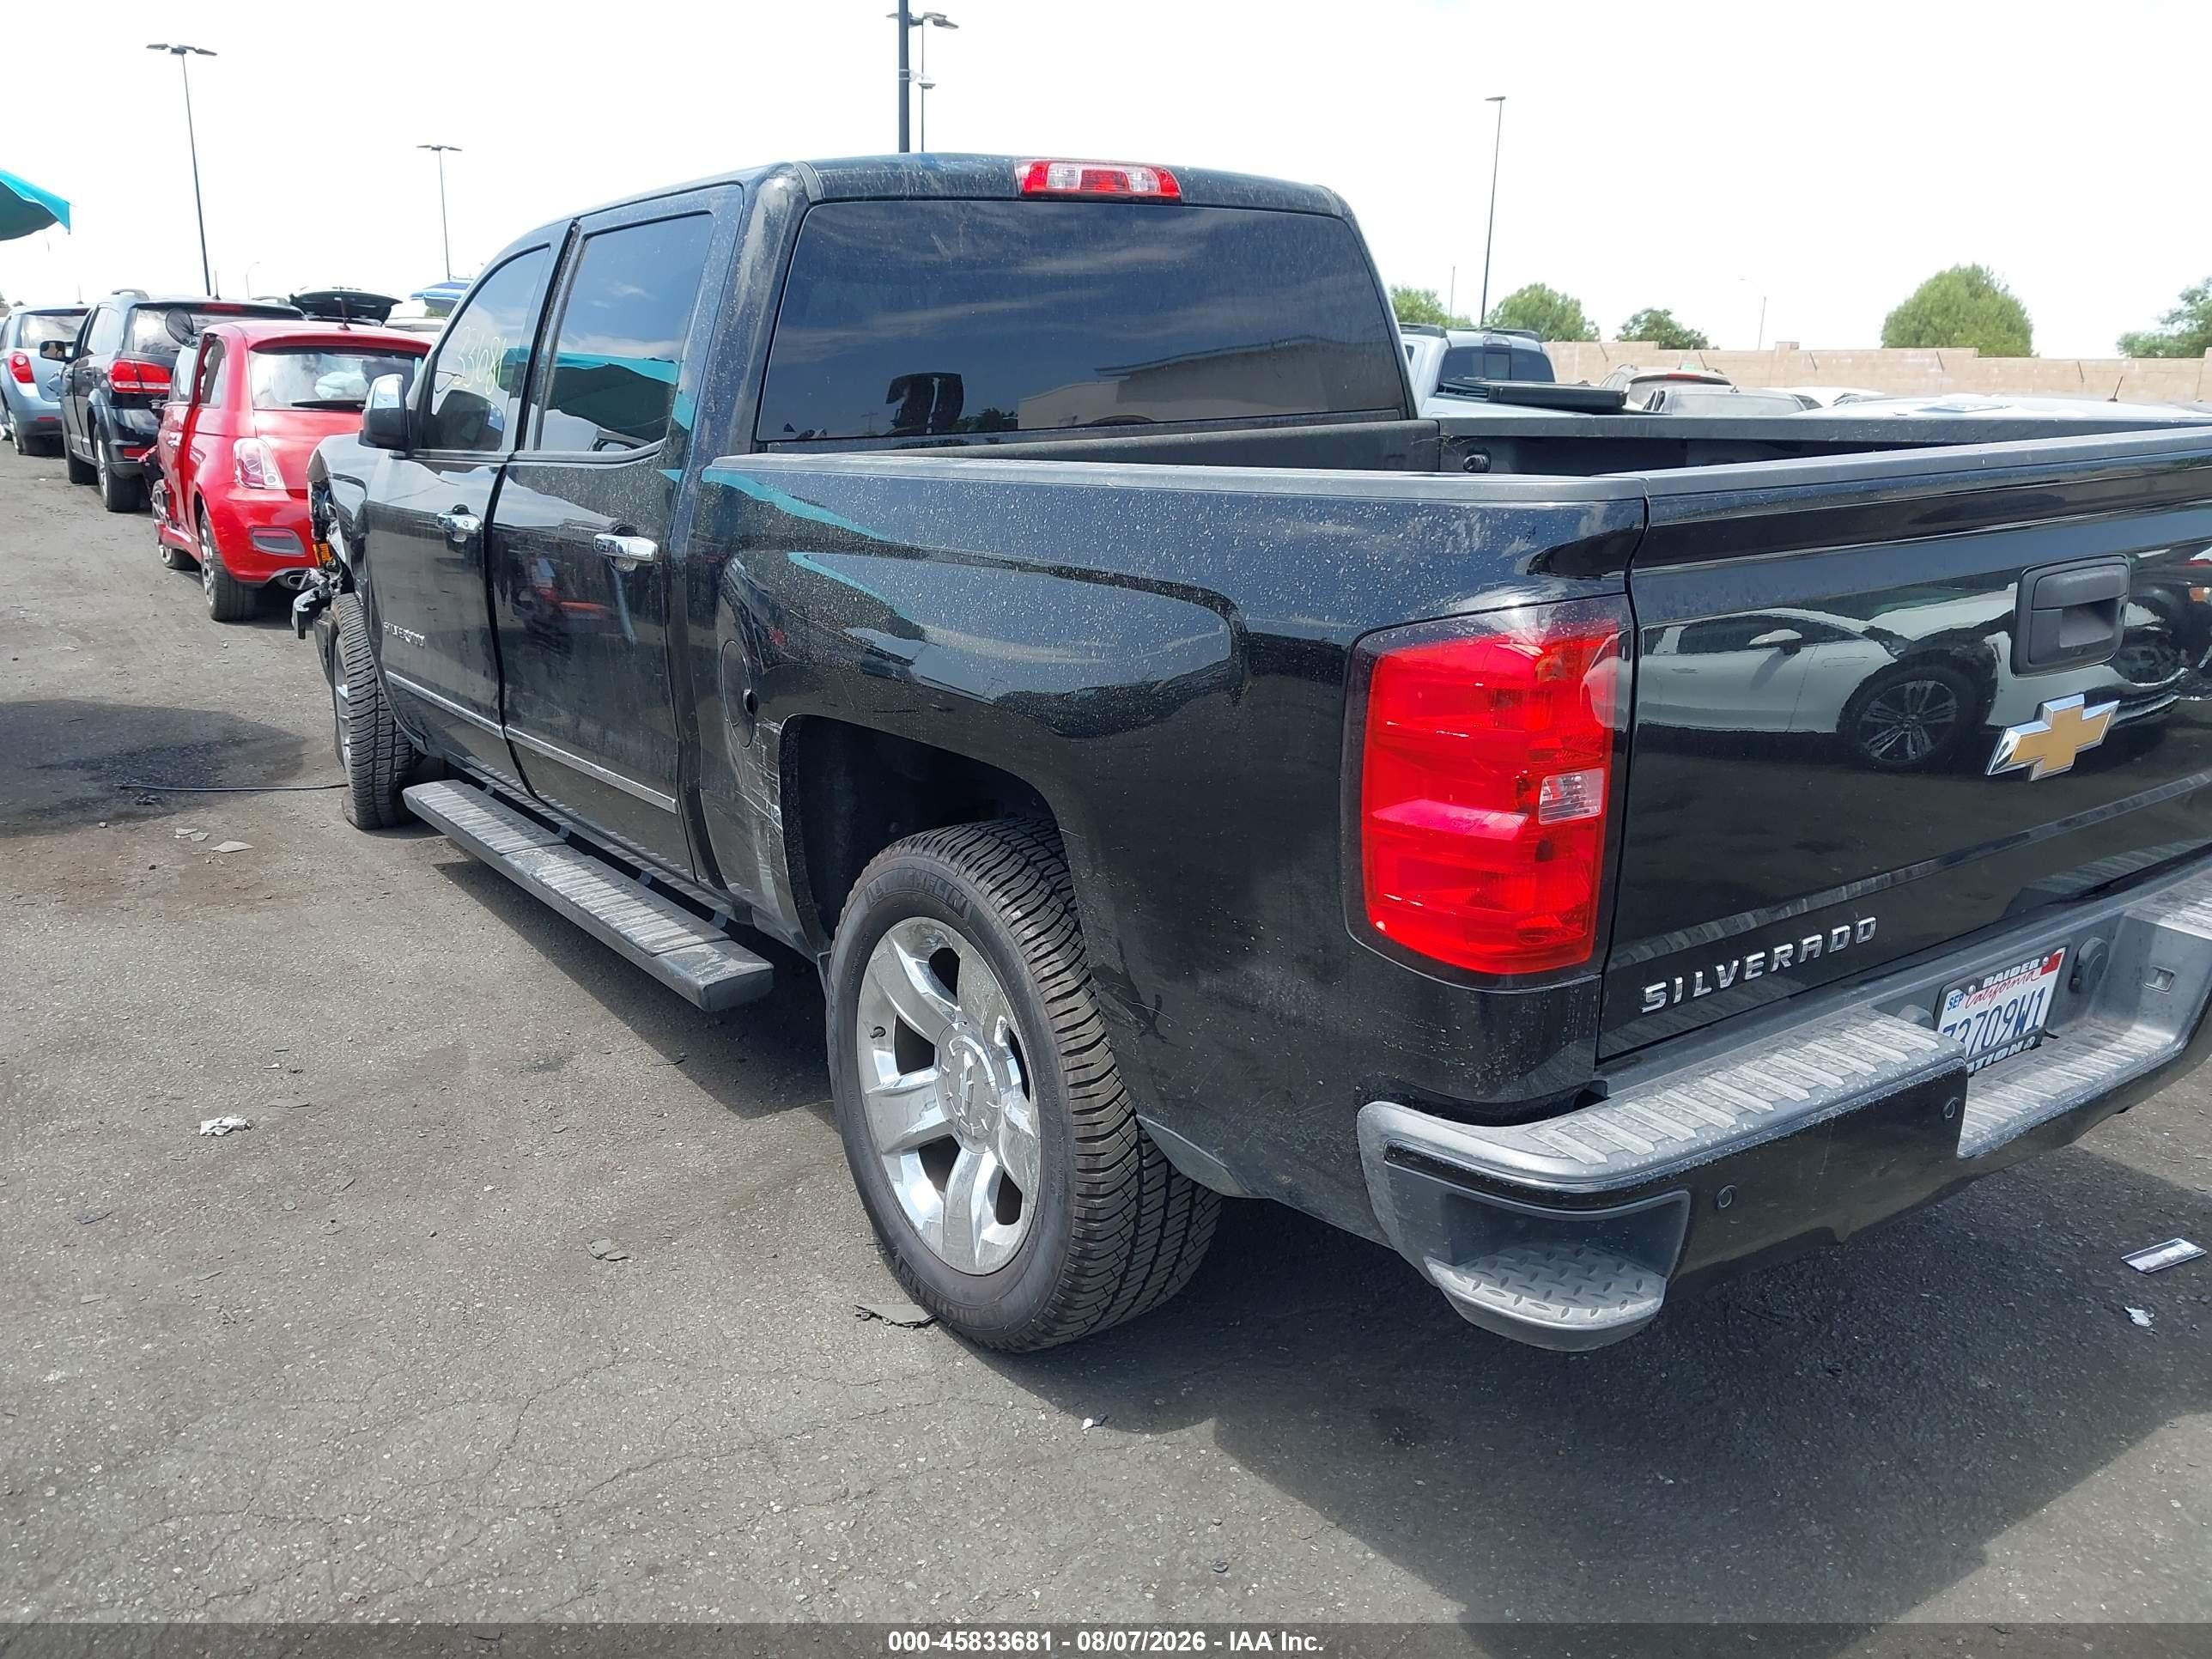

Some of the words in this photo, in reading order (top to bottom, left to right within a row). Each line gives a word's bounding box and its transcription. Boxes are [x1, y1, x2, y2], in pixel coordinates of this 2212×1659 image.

[1641, 916, 1877, 1013] SILVERADO
[1982, 958, 2040, 989] RAIDER
[1947, 992, 1965, 1012] SEP
[1965, 969, 2041, 1010] California
